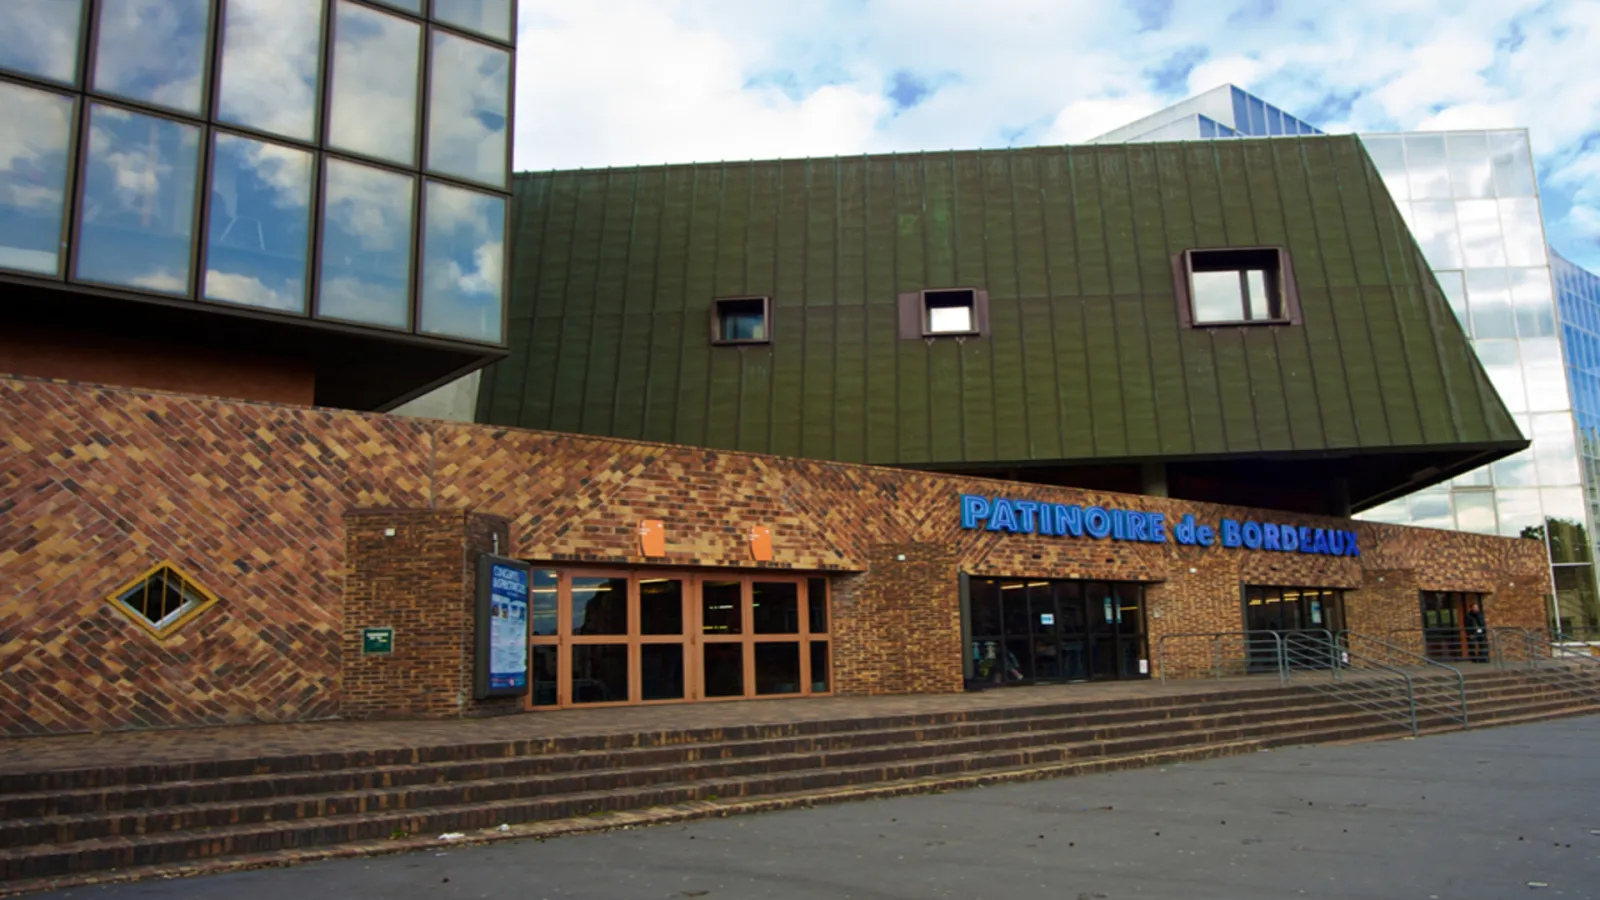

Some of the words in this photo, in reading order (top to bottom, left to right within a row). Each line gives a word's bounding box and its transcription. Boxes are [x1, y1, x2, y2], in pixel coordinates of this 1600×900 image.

[961, 494, 1166, 543] PATINOIRE
[1175, 513, 1214, 547] de
[1221, 518, 1360, 556] BORDEAUX
